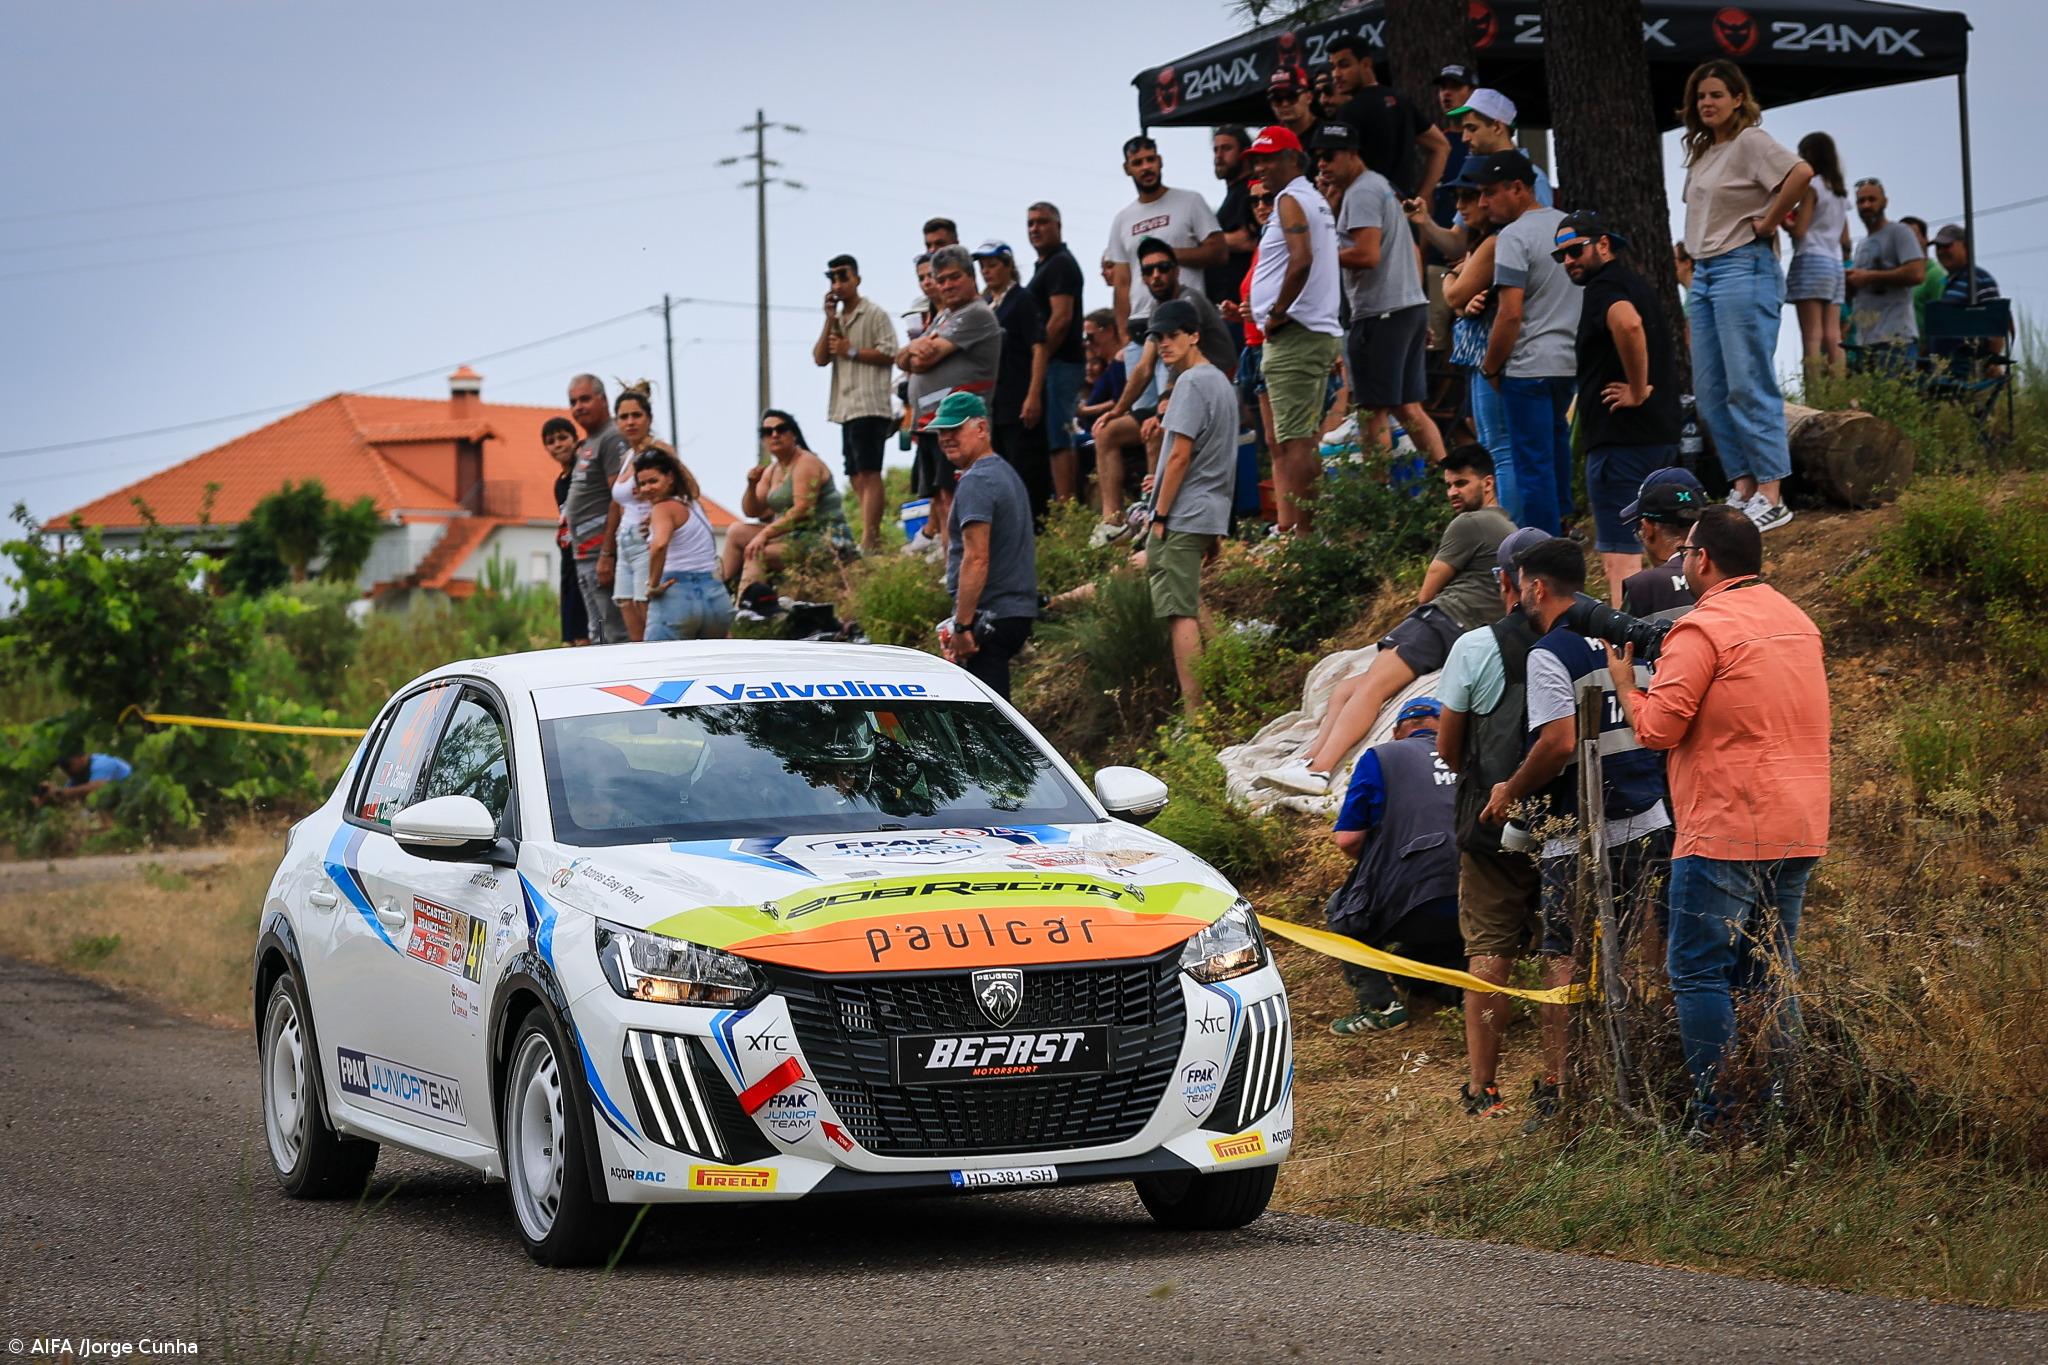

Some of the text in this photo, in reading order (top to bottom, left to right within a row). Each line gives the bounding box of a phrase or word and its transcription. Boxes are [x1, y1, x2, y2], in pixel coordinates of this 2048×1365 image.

[1771, 22, 1925, 57] 24MX
[1183, 53, 1260, 100] 24MX
[705, 680, 928, 700] Valvoline
[834, 839, 949, 849] FPAK
[620, 886, 646, 904] Rent
[865, 913, 1095, 963] paulcar
[467, 919, 486, 982] 41
[976, 973, 1020, 981] PEUGEOT
[1194, 999, 1226, 1035] XTC
[744, 1016, 790, 1052] XTC
[924, 1031, 1086, 1069] BEFAST
[340, 1055, 369, 1089] FPAK
[972, 1065, 1039, 1076] MOTORSPORT
[1187, 1067, 1214, 1084] FPAK
[1182, 1083, 1217, 1096] JUNIOR
[1186, 1092, 1213, 1103] TEAM
[768, 1093, 810, 1109] FPAK
[764, 1110, 817, 1120] JUNIOR
[769, 1119, 811, 1129] TEAM
[1214, 1135, 1262, 1159] PIRELLI
[696, 1169, 770, 1188] PIRELLI
[967, 1169, 1053, 1185] HD-381-SH
